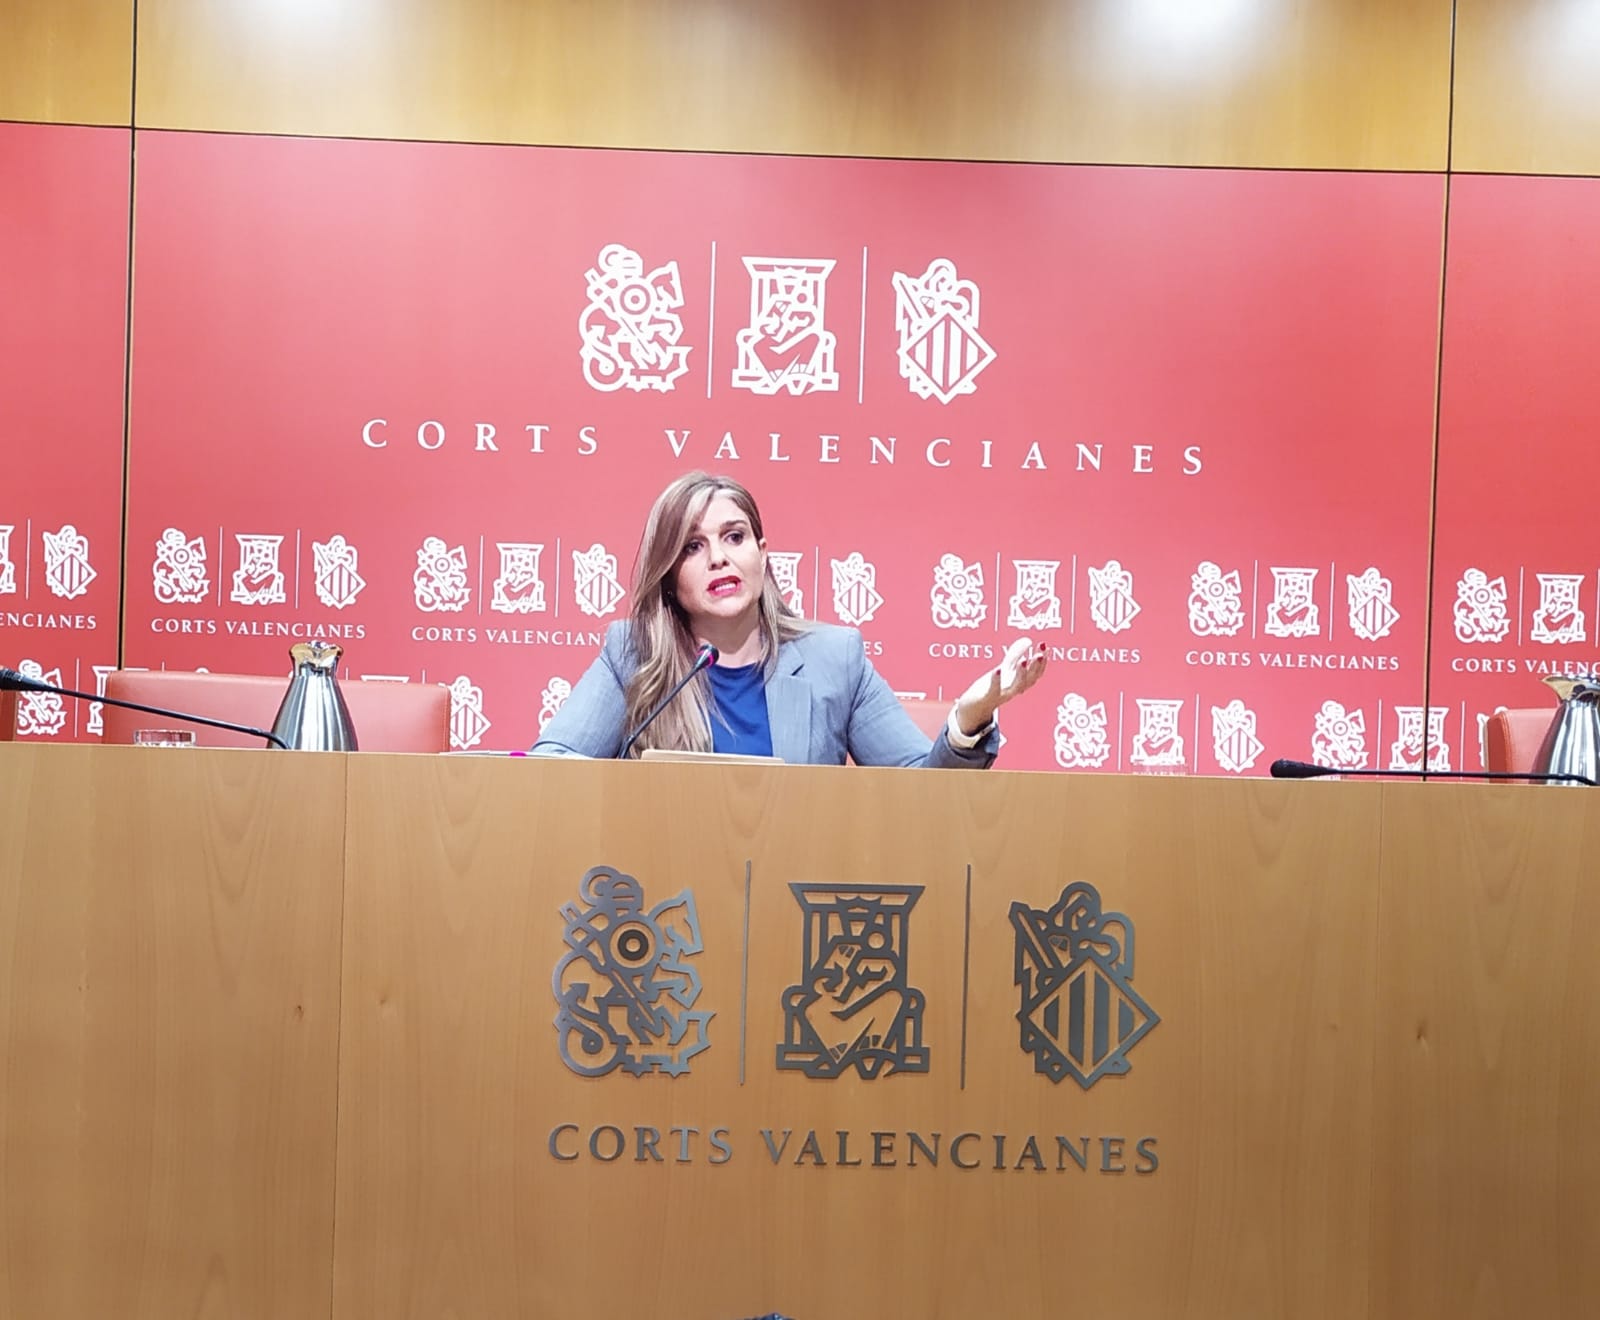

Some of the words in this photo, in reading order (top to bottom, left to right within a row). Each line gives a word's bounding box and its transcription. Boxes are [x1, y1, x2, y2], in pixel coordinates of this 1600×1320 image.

[362, 419, 598, 456] CORTS
[664, 429, 1203, 476] VALENCIANES
[151, 618, 217, 634] CORTS
[225, 620, 366, 639] VALENCIANES
[411, 626, 477, 643] CORTS
[485, 629, 606, 647] VALENCIAN
[928, 643, 993, 659] CORTS
[1185, 650, 1251, 667] CORTS
[1258, 652, 1399, 671] VALENCIANES
[1451, 657, 1517, 673] CORTS
[548, 1123, 733, 1164] CORTS
[759, 1129, 1159, 1174] VALENCIANES
